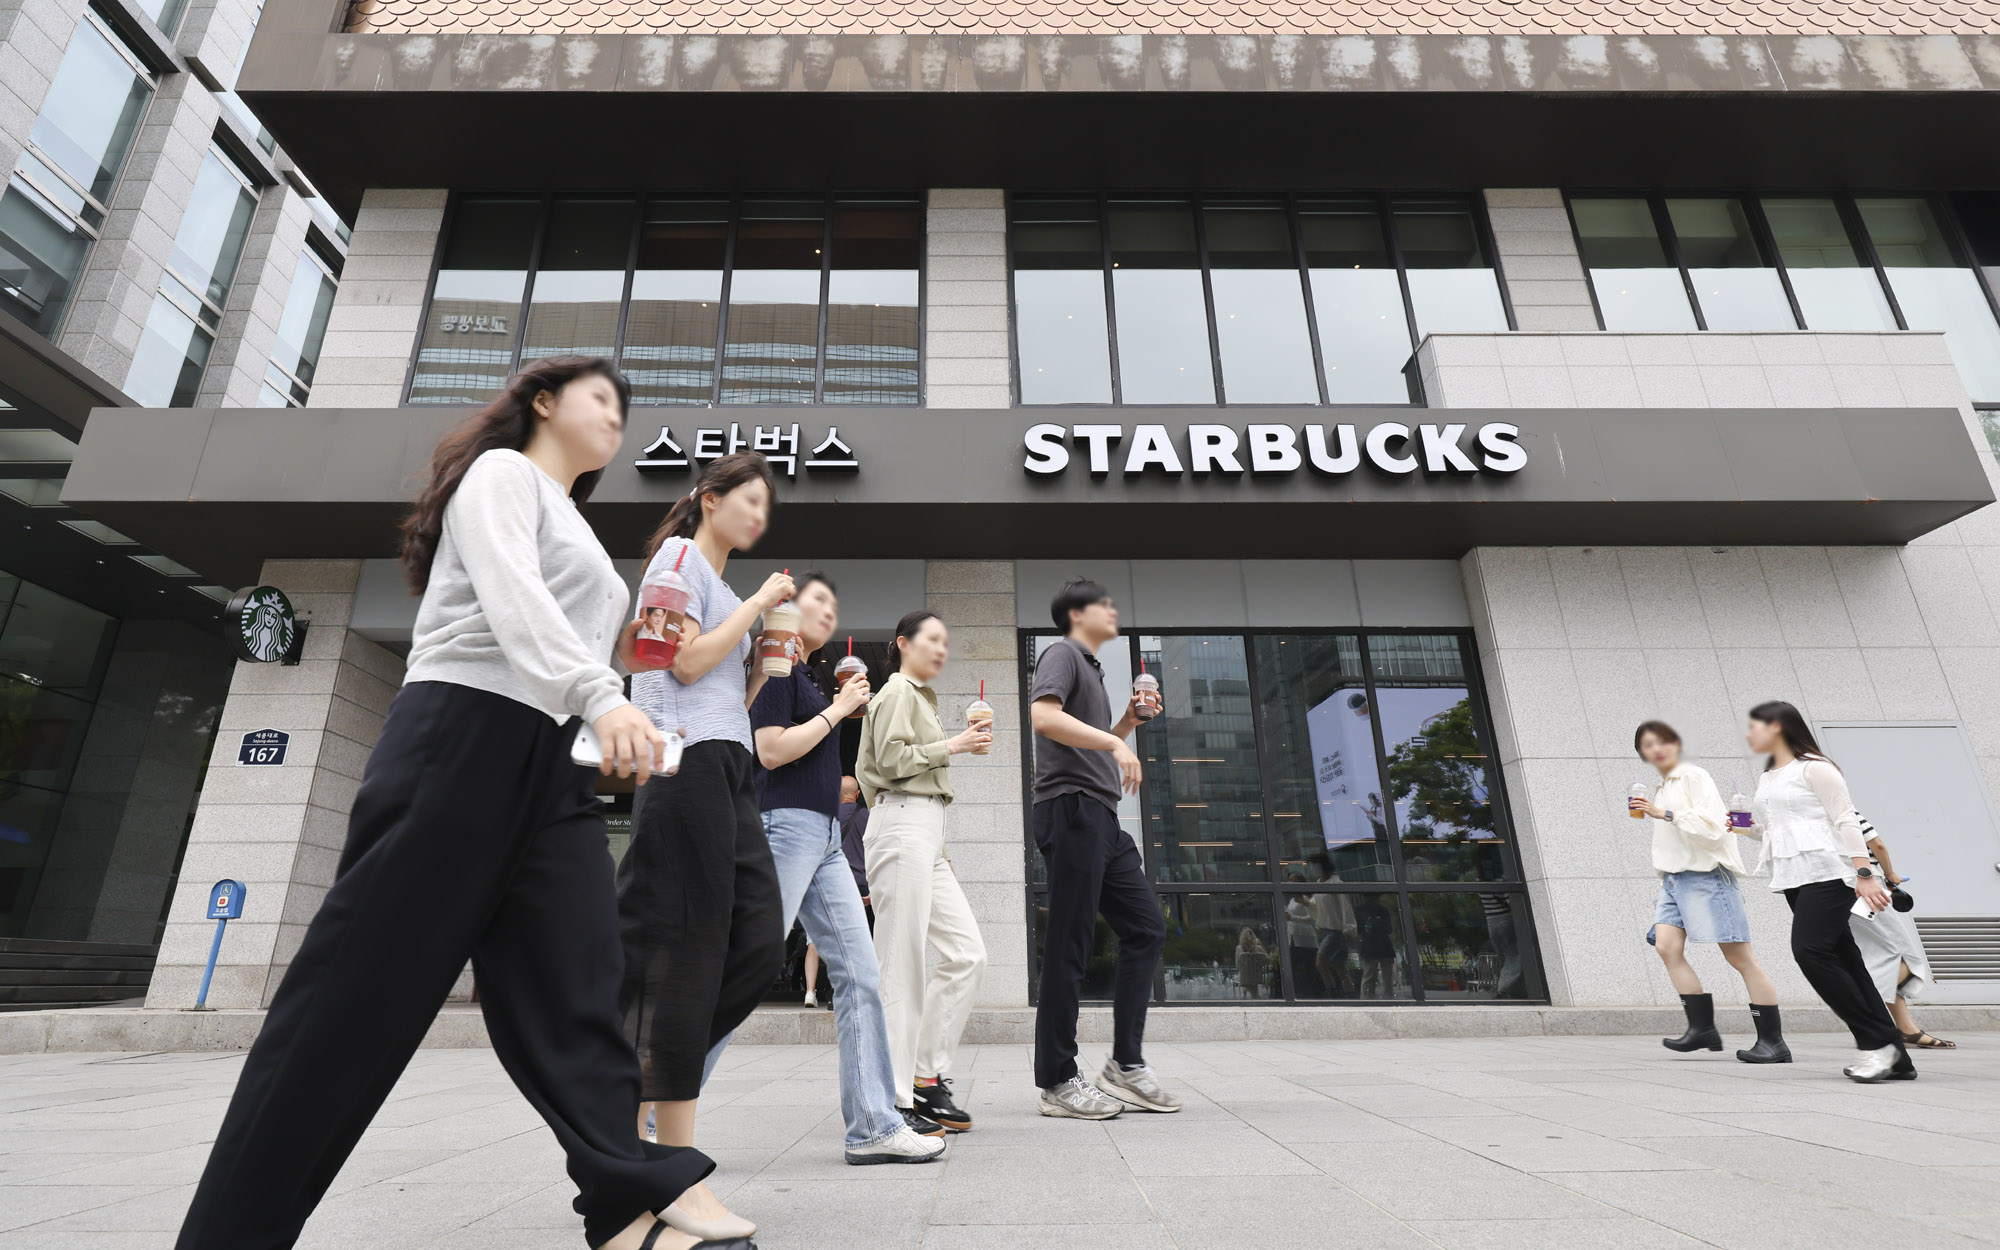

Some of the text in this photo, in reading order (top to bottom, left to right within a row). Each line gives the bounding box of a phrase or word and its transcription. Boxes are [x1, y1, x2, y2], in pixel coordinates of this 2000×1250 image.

[634, 422, 860, 477] 스타벅스
[1023, 421, 1528, 475] STARBUCKS
[249, 747, 279, 762] 167
